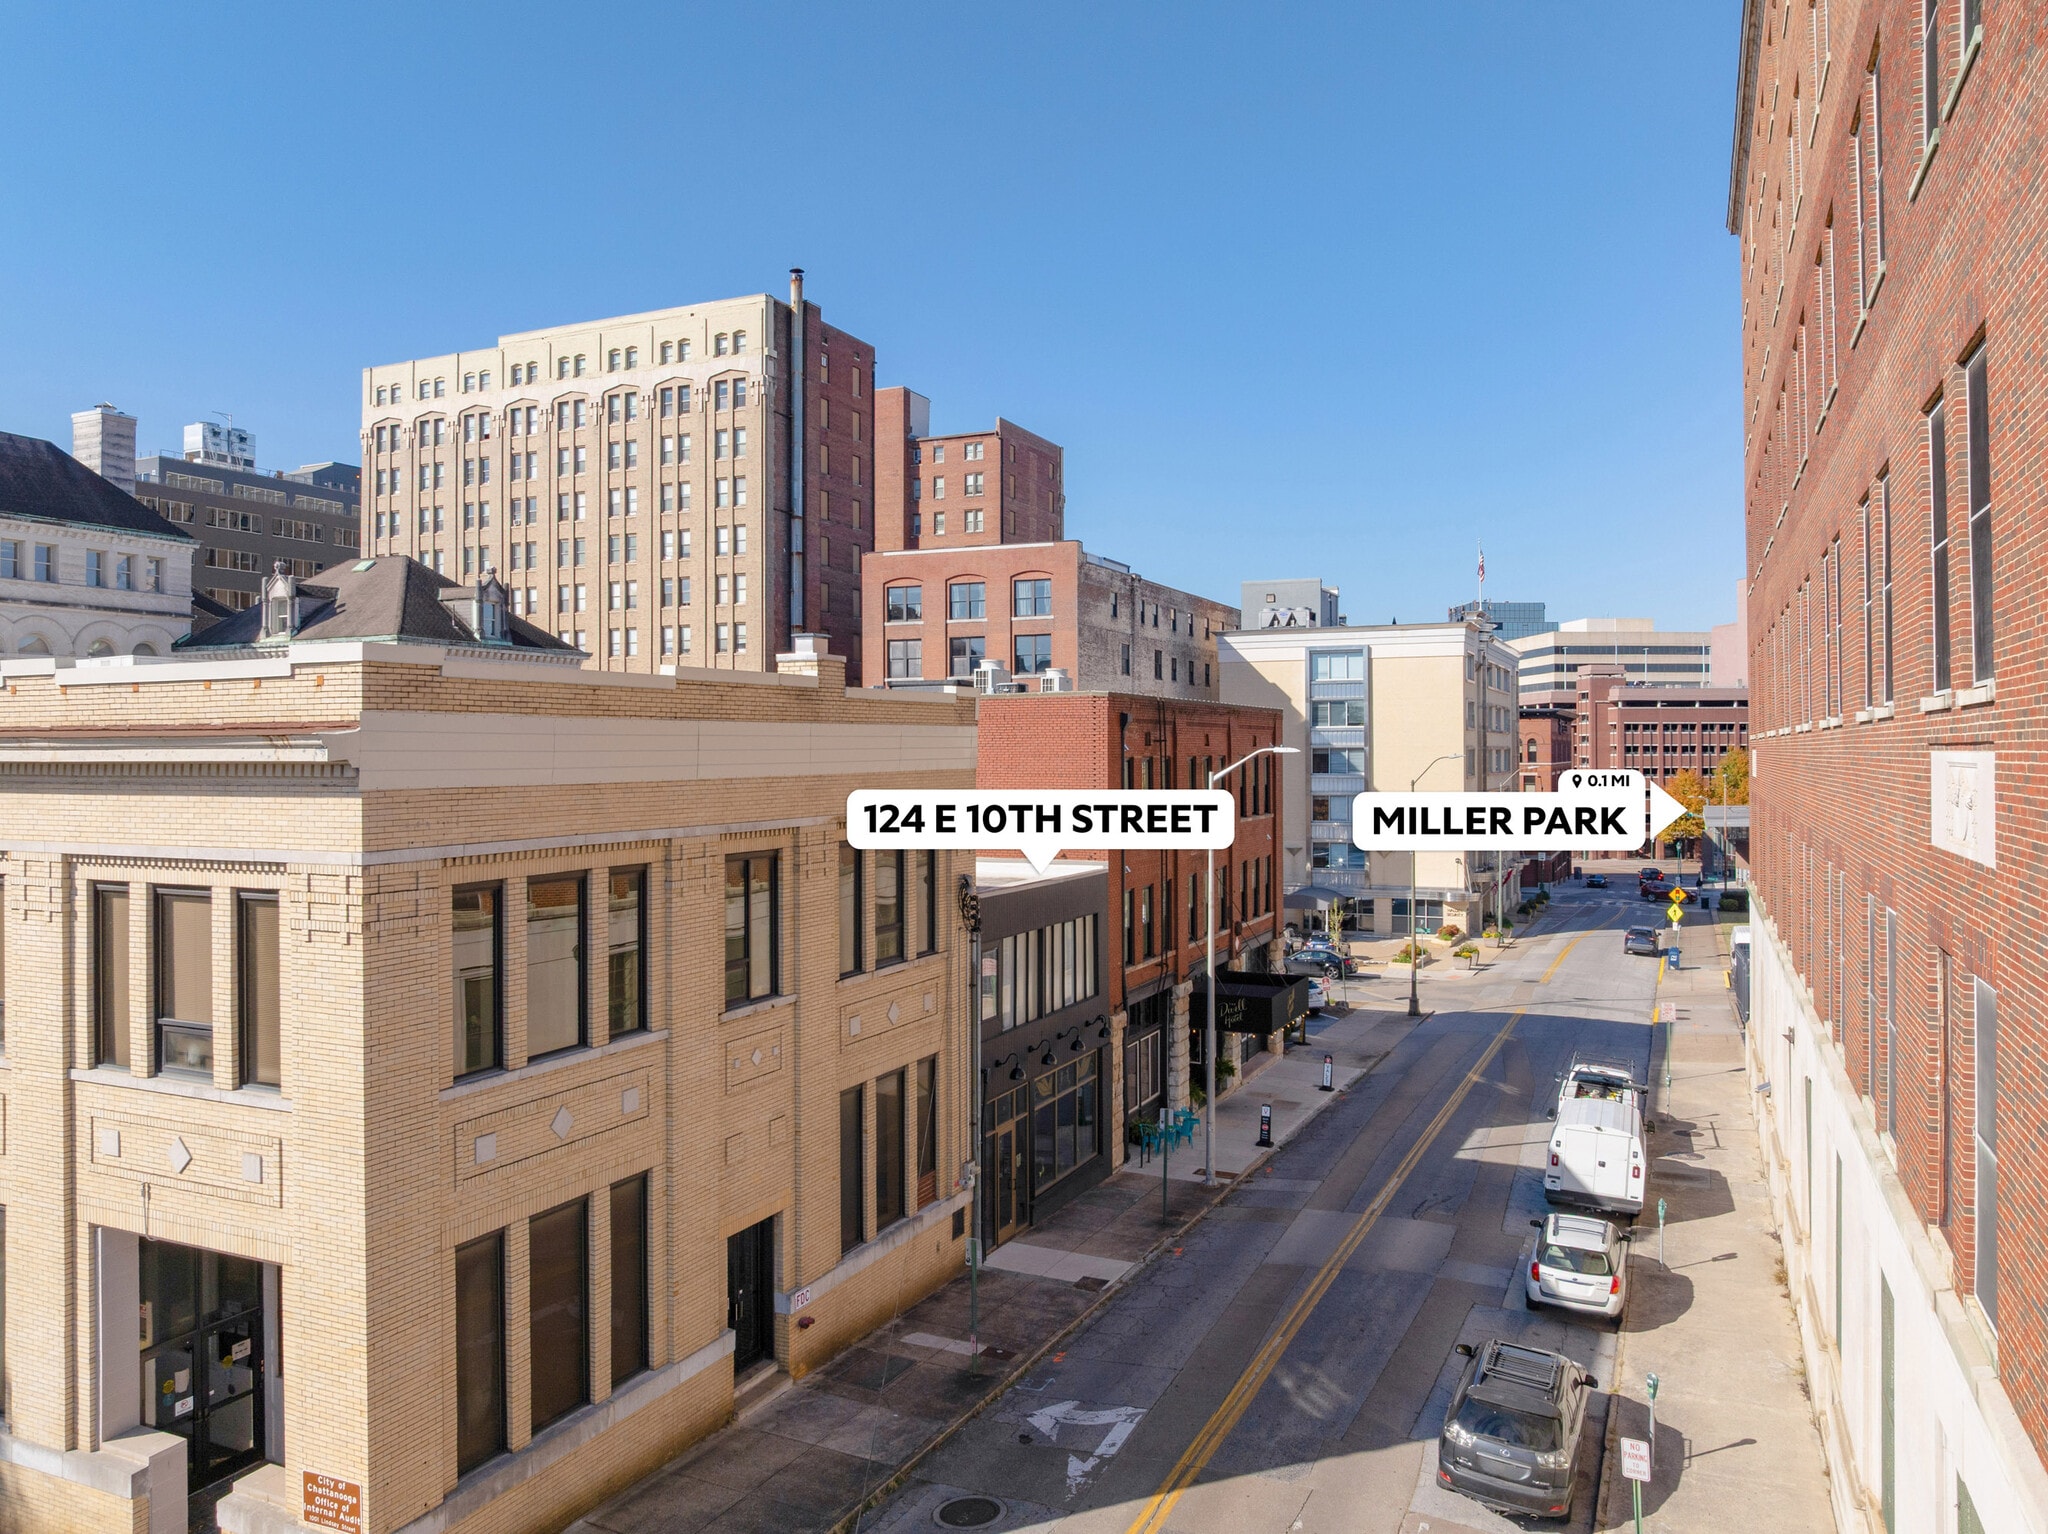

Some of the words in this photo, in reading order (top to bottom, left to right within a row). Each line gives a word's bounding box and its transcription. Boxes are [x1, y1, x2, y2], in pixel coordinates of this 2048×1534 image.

[796, 1289, 810, 1308] FDC
[1630, 1443, 1640, 1452] NO
[1623, 1451, 1648, 1462] PARKING
[317, 1475, 335, 1489] City
[338, 1482, 346, 1490] of
[307, 1483, 357, 1504] Chattanooga
[315, 1496, 338, 1510] Office
[341, 1504, 349, 1513] of
[303, 1502, 336, 1518] Internal
[339, 1512, 360, 1526] Audit
